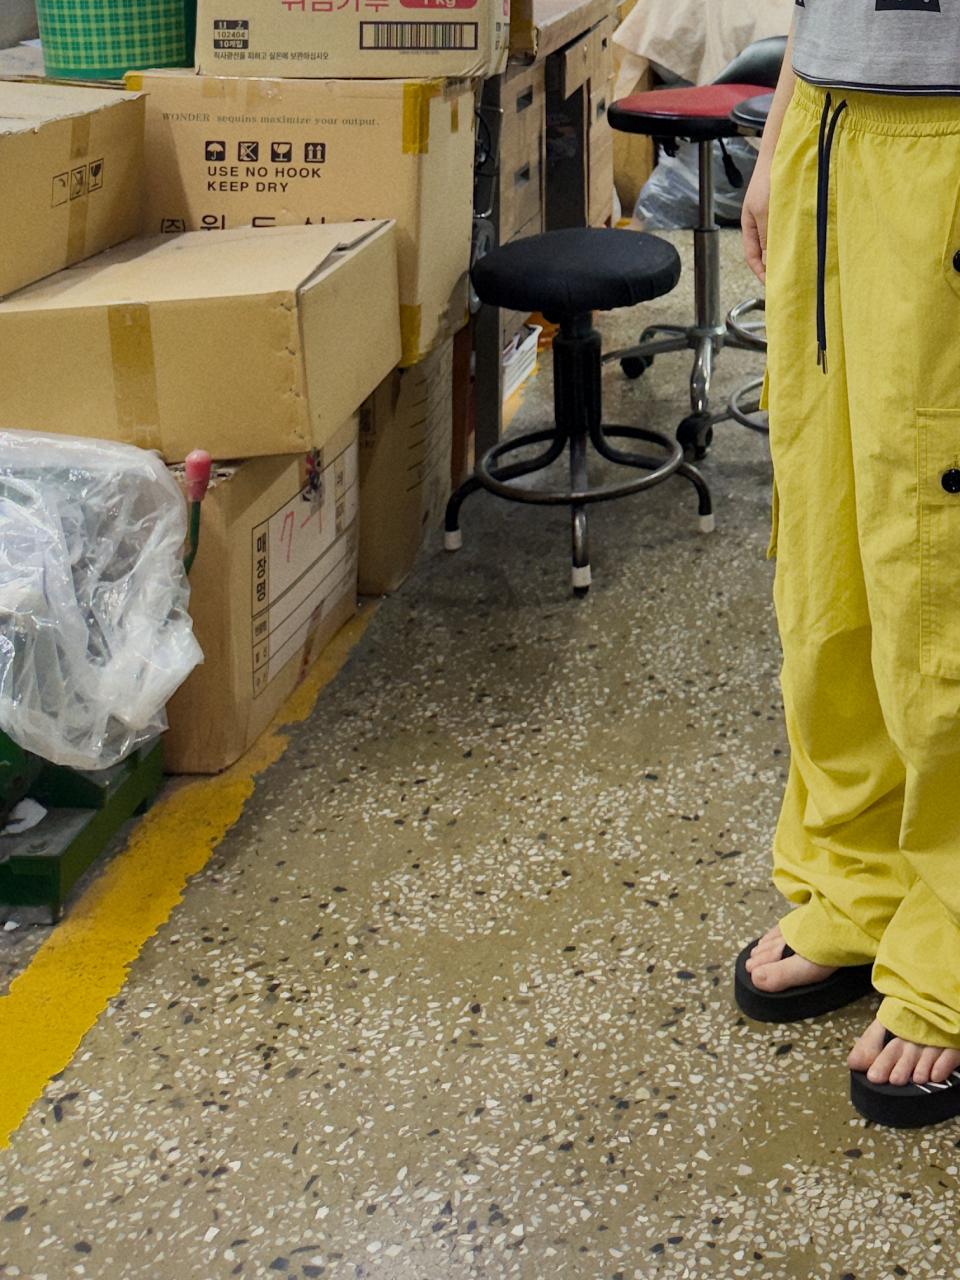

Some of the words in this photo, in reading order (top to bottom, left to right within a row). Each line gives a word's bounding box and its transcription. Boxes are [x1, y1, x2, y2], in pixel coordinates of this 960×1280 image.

[162, 112, 210, 122] WONDER
[207, 166, 239, 177] USE
[246, 166, 268, 178] NO
[275, 167, 321, 178] HOOK
[207, 181, 249, 192] KEEP
[256, 181, 289, 193] DRY
